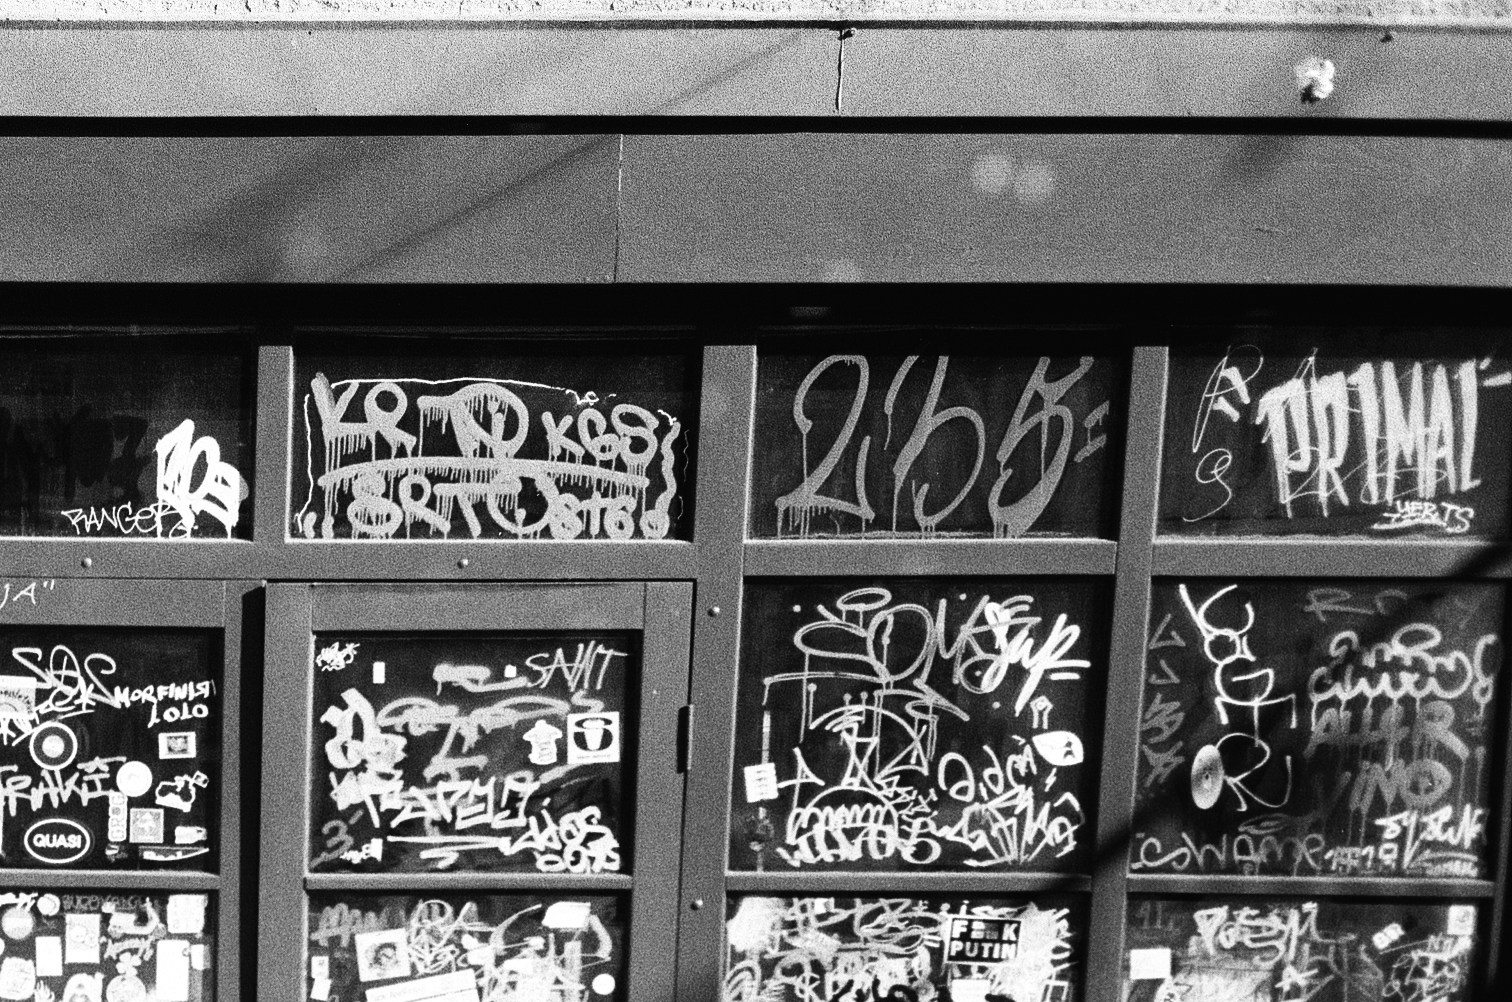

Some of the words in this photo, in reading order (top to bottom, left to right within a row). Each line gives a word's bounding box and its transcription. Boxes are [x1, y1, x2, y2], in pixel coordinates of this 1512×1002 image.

[33, 834, 83, 850] QUASI
[951, 920, 1019, 942] FK
[949, 941, 1018, 959] PUTIN
